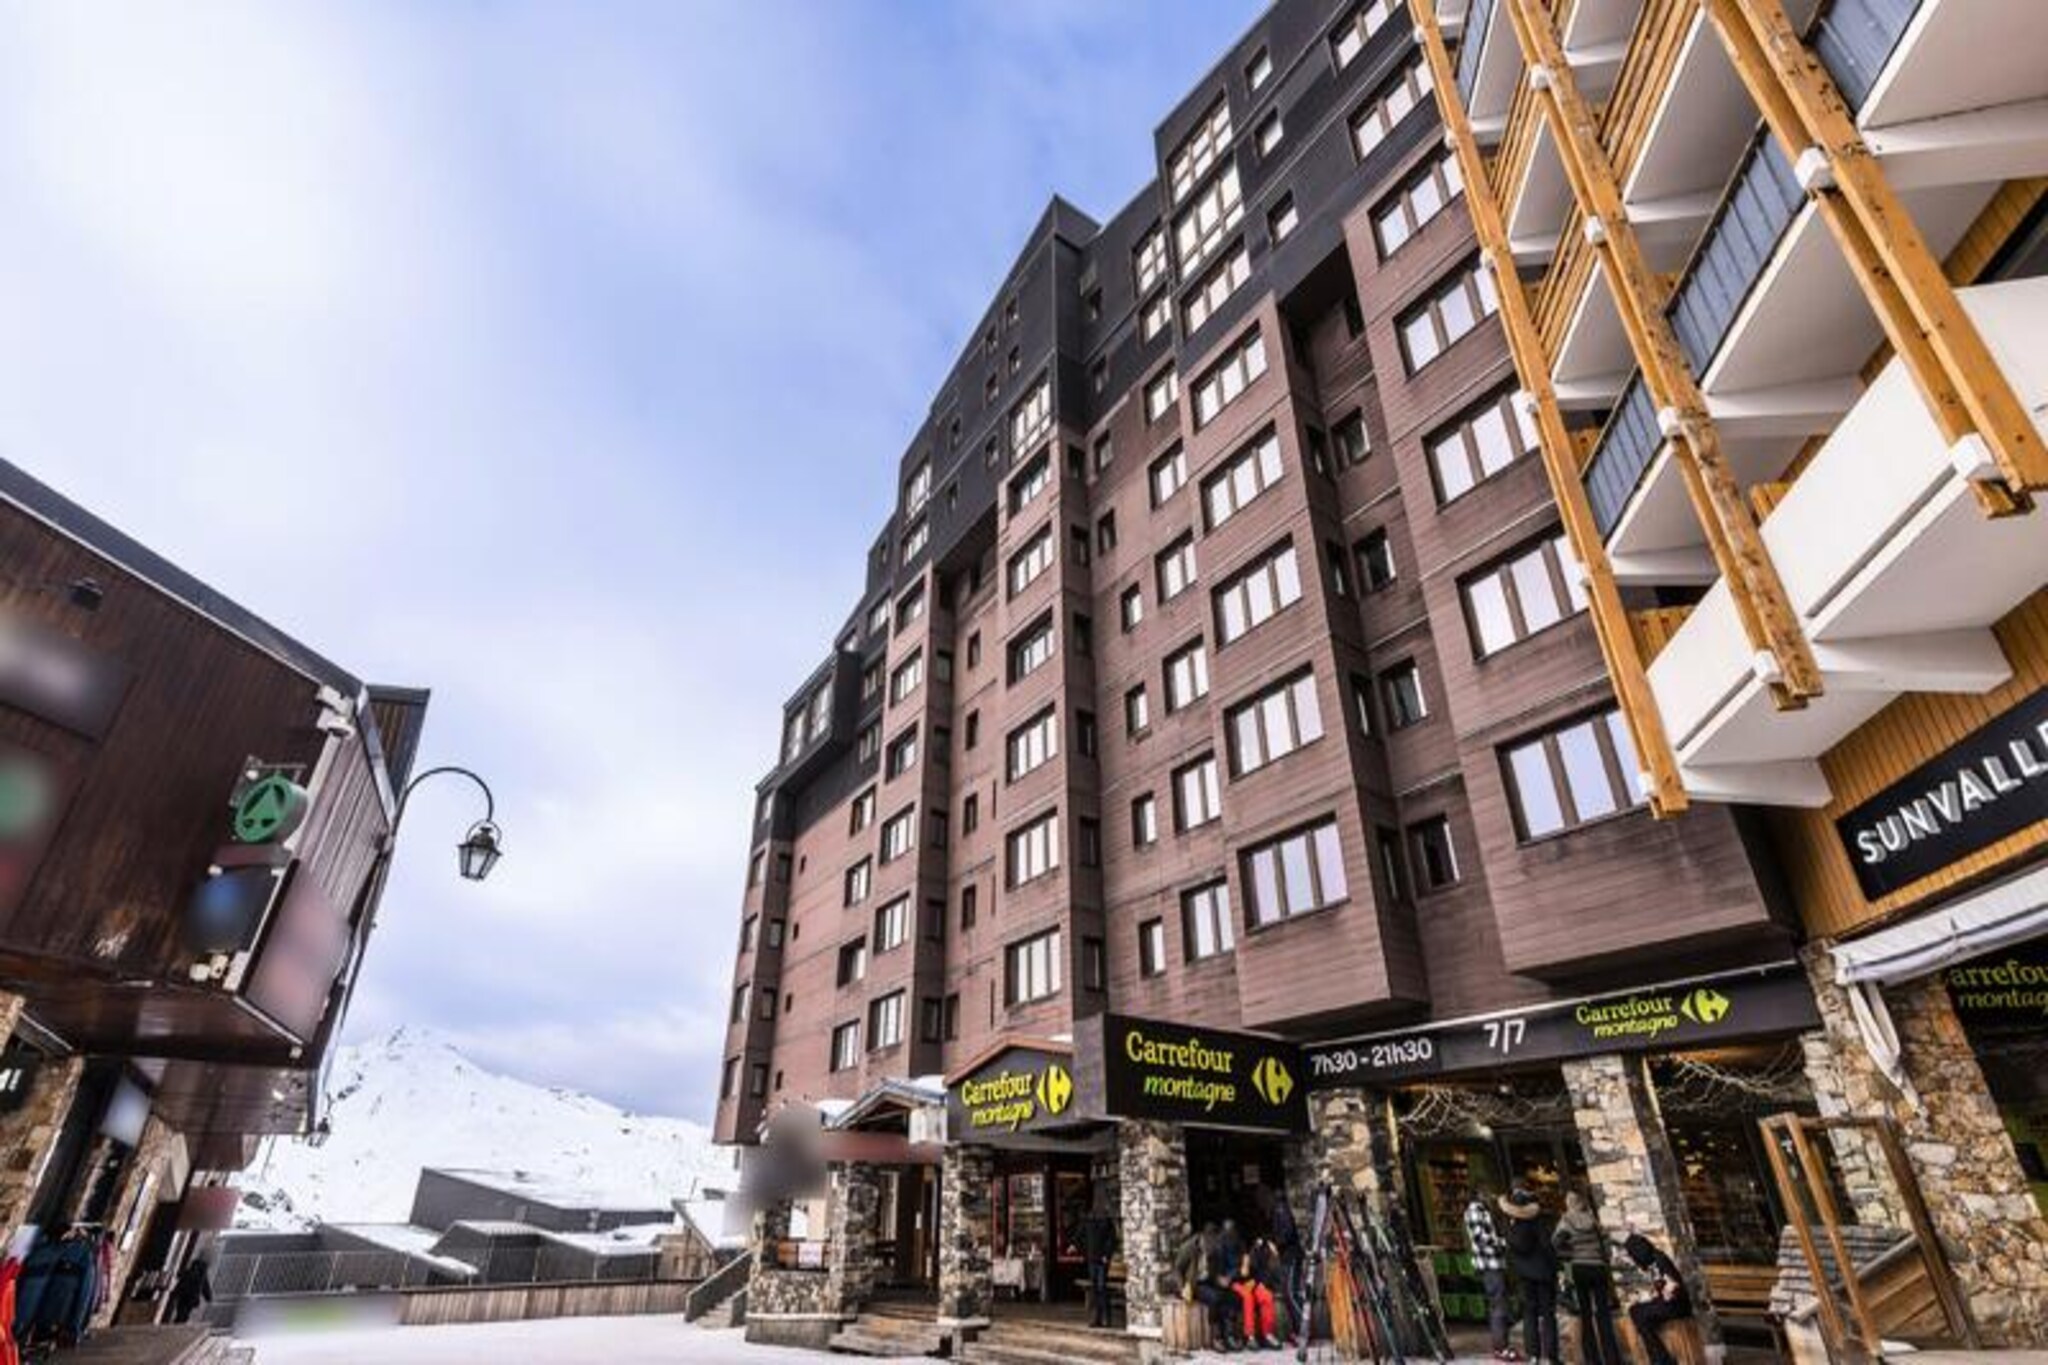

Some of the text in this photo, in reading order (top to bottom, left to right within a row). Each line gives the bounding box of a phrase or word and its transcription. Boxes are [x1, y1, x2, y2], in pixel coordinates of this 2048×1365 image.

[1576, 997, 1672, 1024] Carrefour
[1594, 1015, 1678, 1038] montagne
[1126, 1031, 1234, 1073] Carrefour
[1311, 1050, 1357, 1075] 7h30
[1371, 1038, 1432, 1067] 21h30
[962, 1071, 1032, 1106] Carrefour
[1144, 1076, 1235, 1111] montagne
[972, 1100, 1033, 1133] montagne
